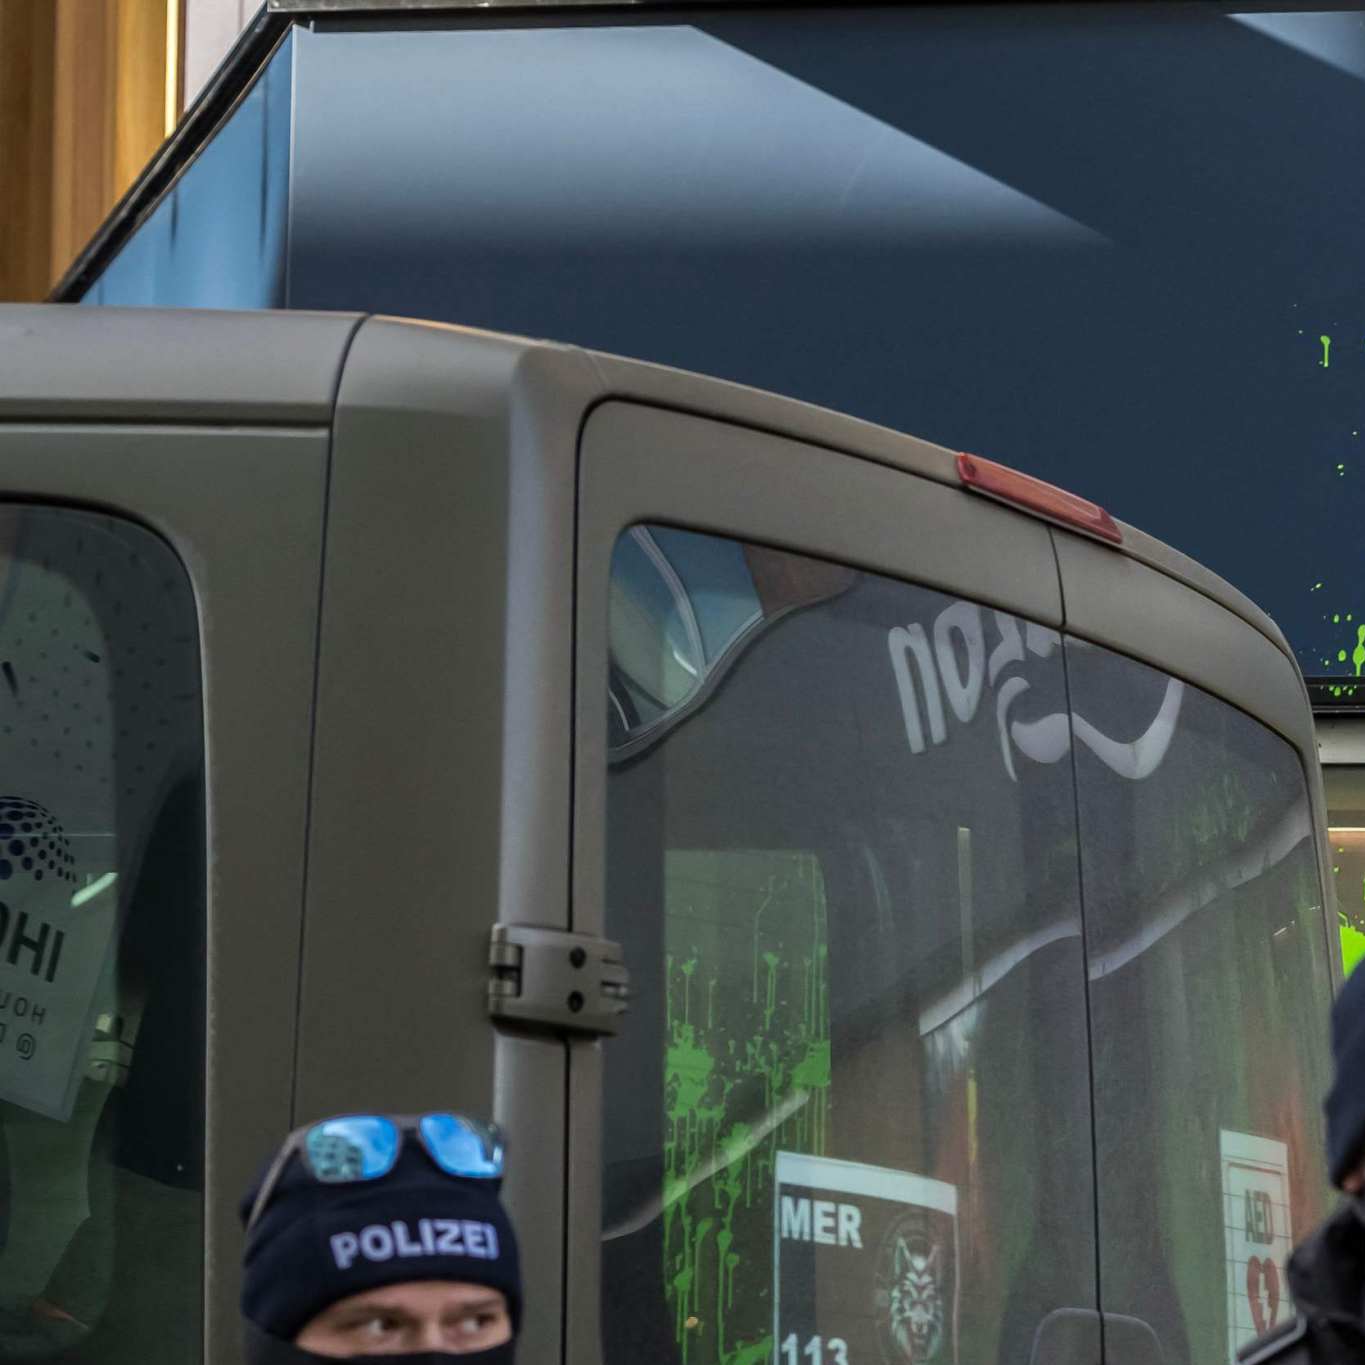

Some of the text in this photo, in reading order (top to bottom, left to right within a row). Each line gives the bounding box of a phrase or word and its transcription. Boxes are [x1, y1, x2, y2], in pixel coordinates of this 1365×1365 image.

[781, 1195, 863, 1249] MER
[1244, 1188, 1274, 1245] AED
[330, 1218, 499, 1271] POLIZEI
